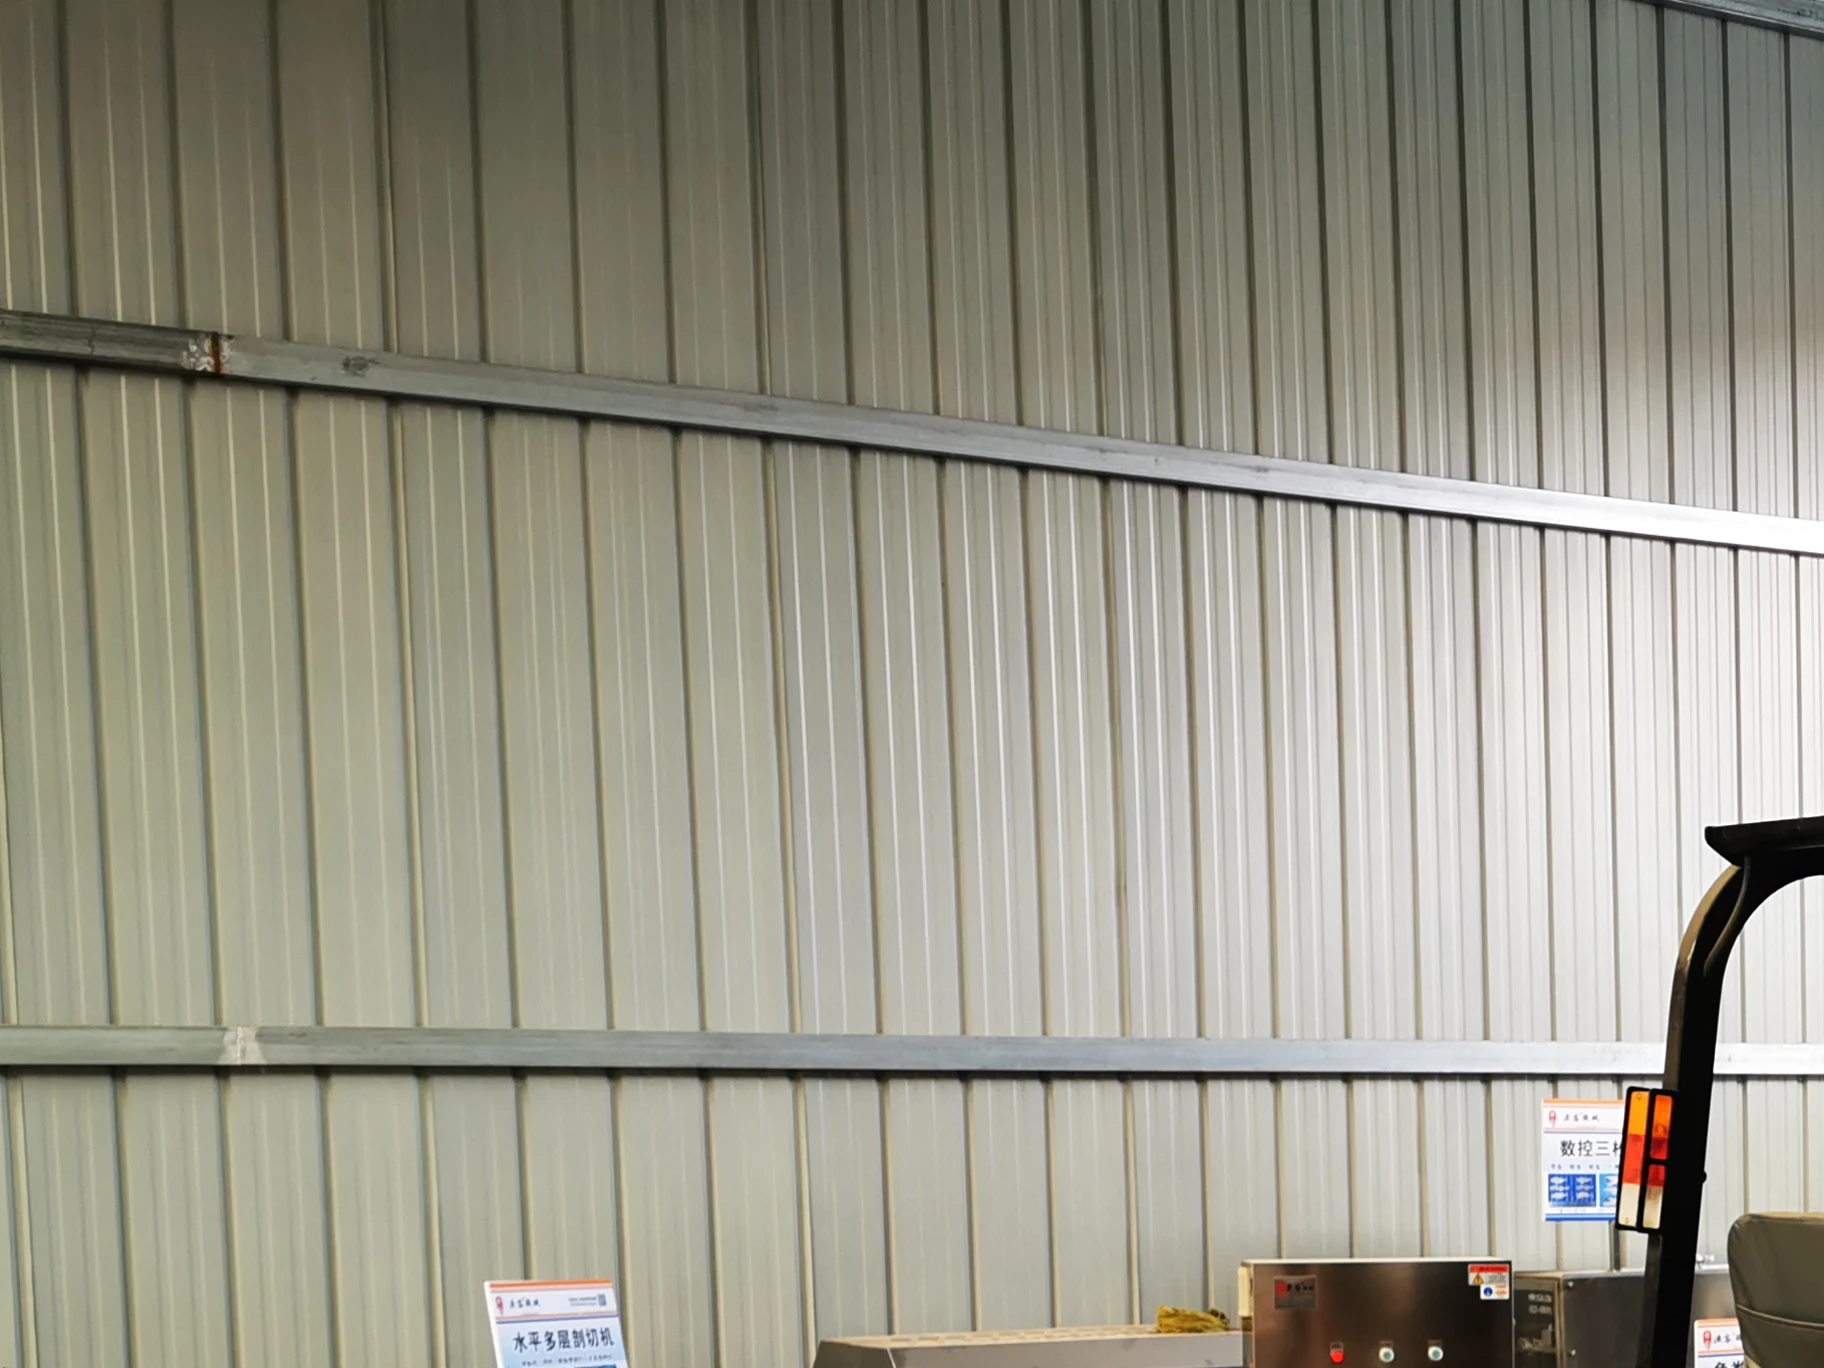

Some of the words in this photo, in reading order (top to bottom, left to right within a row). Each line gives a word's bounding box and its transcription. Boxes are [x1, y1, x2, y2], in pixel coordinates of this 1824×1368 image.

[512, 1327, 615, 1353] 水平多层剖切机
